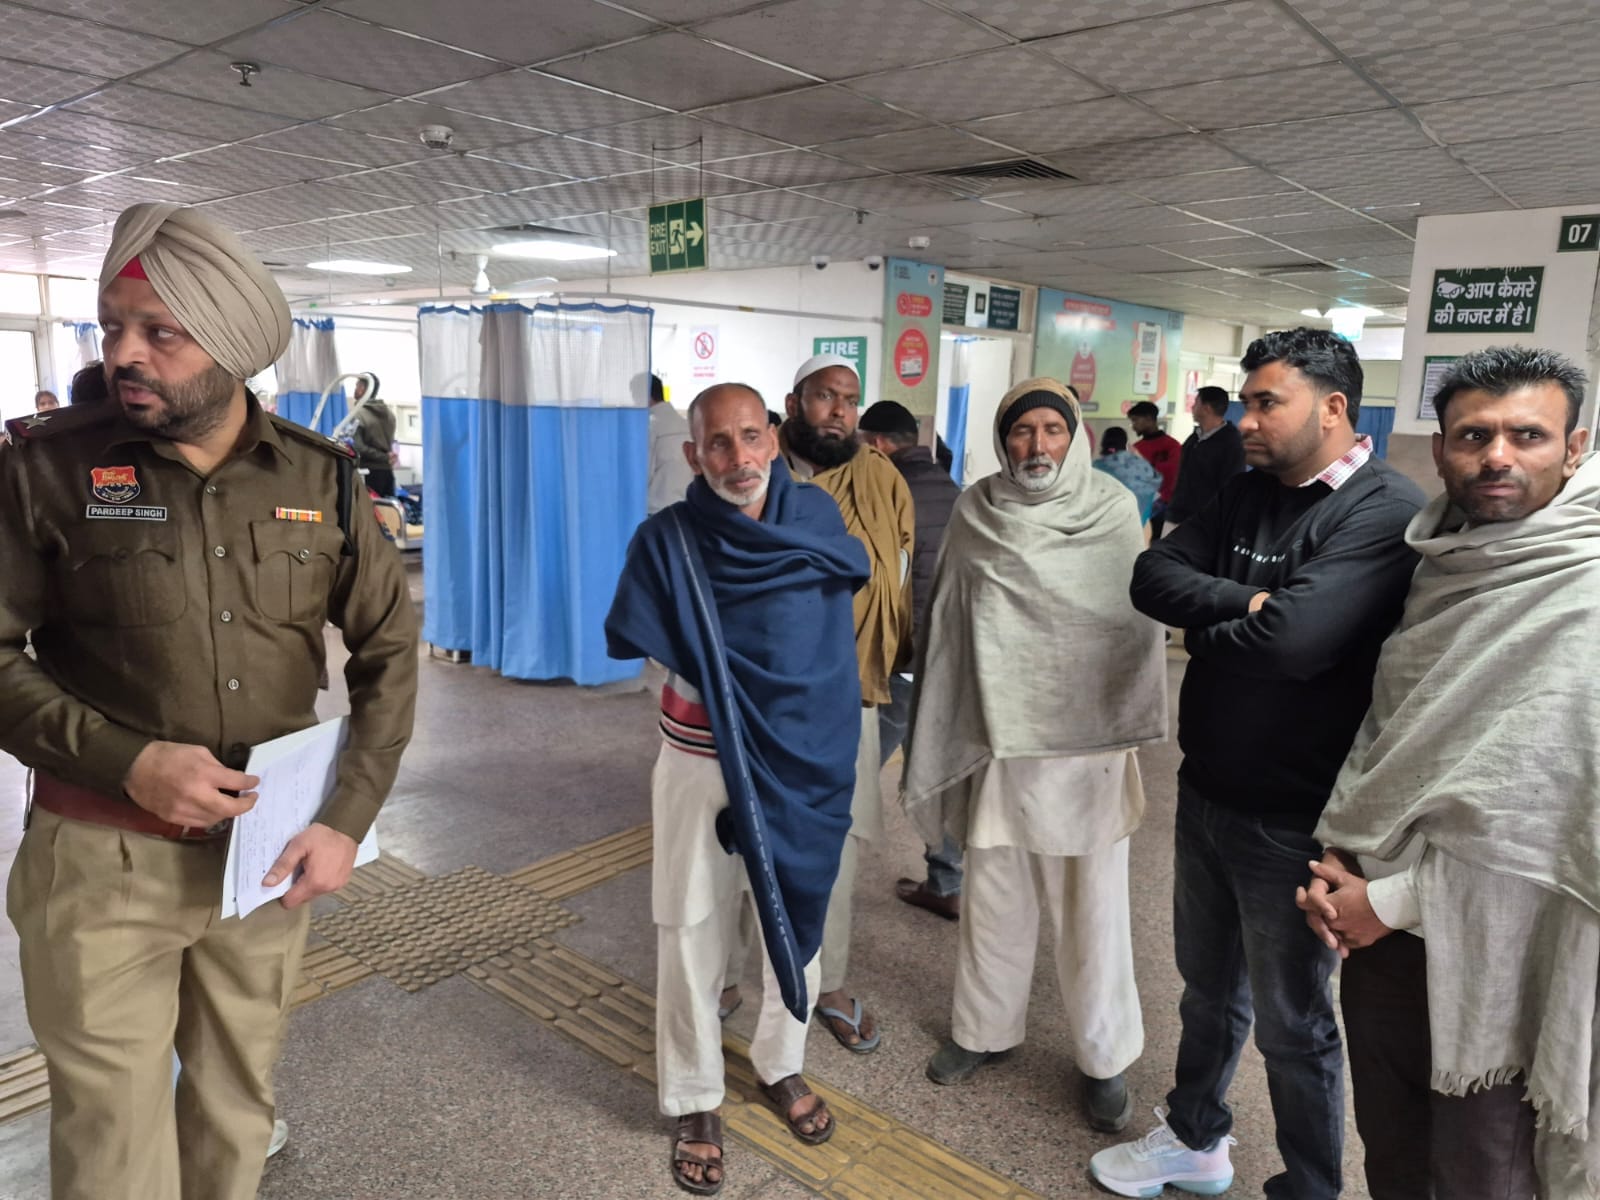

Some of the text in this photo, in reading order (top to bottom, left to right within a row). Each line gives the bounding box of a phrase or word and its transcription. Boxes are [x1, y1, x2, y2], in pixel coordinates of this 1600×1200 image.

[650, 222, 666, 239] FIRE
[1568, 223, 1592, 243] 07
[650, 240, 666, 256] EXIT
[1465, 282, 1496, 299] आप
[1434, 302, 1455, 324] की
[1456, 308, 1494, 324] नजर
[1495, 301, 1512, 324] में
[820, 341, 859, 355] FIRE
[91, 507, 163, 518] PARDEEP SINGH
